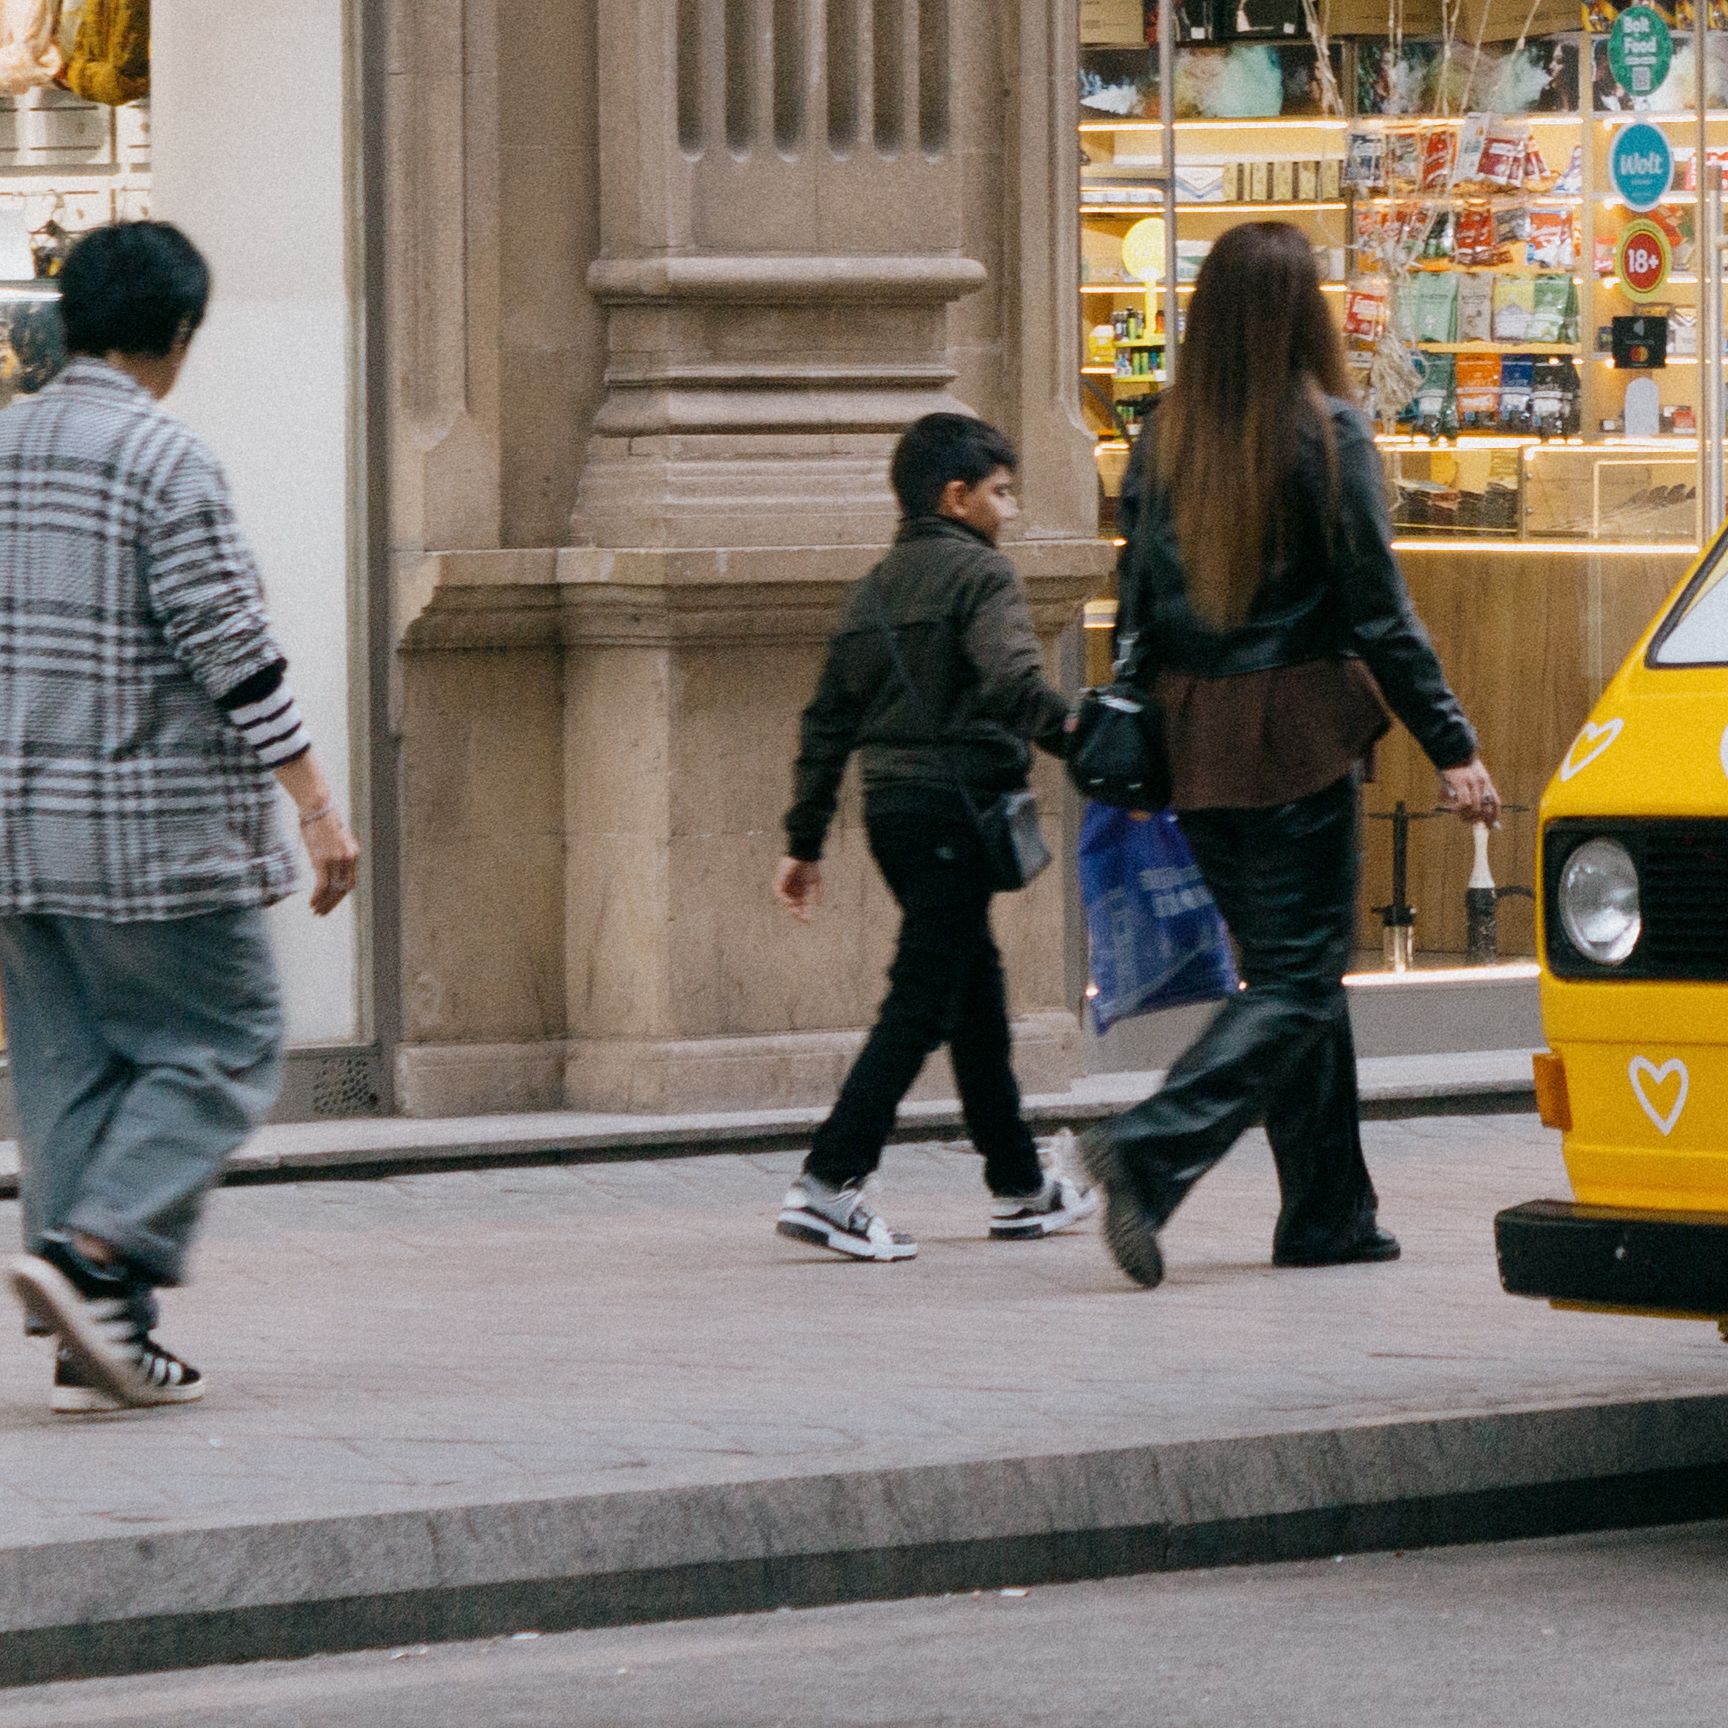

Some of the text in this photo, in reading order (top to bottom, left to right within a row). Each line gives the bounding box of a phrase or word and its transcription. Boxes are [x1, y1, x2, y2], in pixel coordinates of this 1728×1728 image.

[1622, 14, 1651, 33] Bolt
[1622, 35, 1658, 54] Food
[1618, 151, 1664, 175] Wolt
[1627, 248, 1660, 274] 18+
